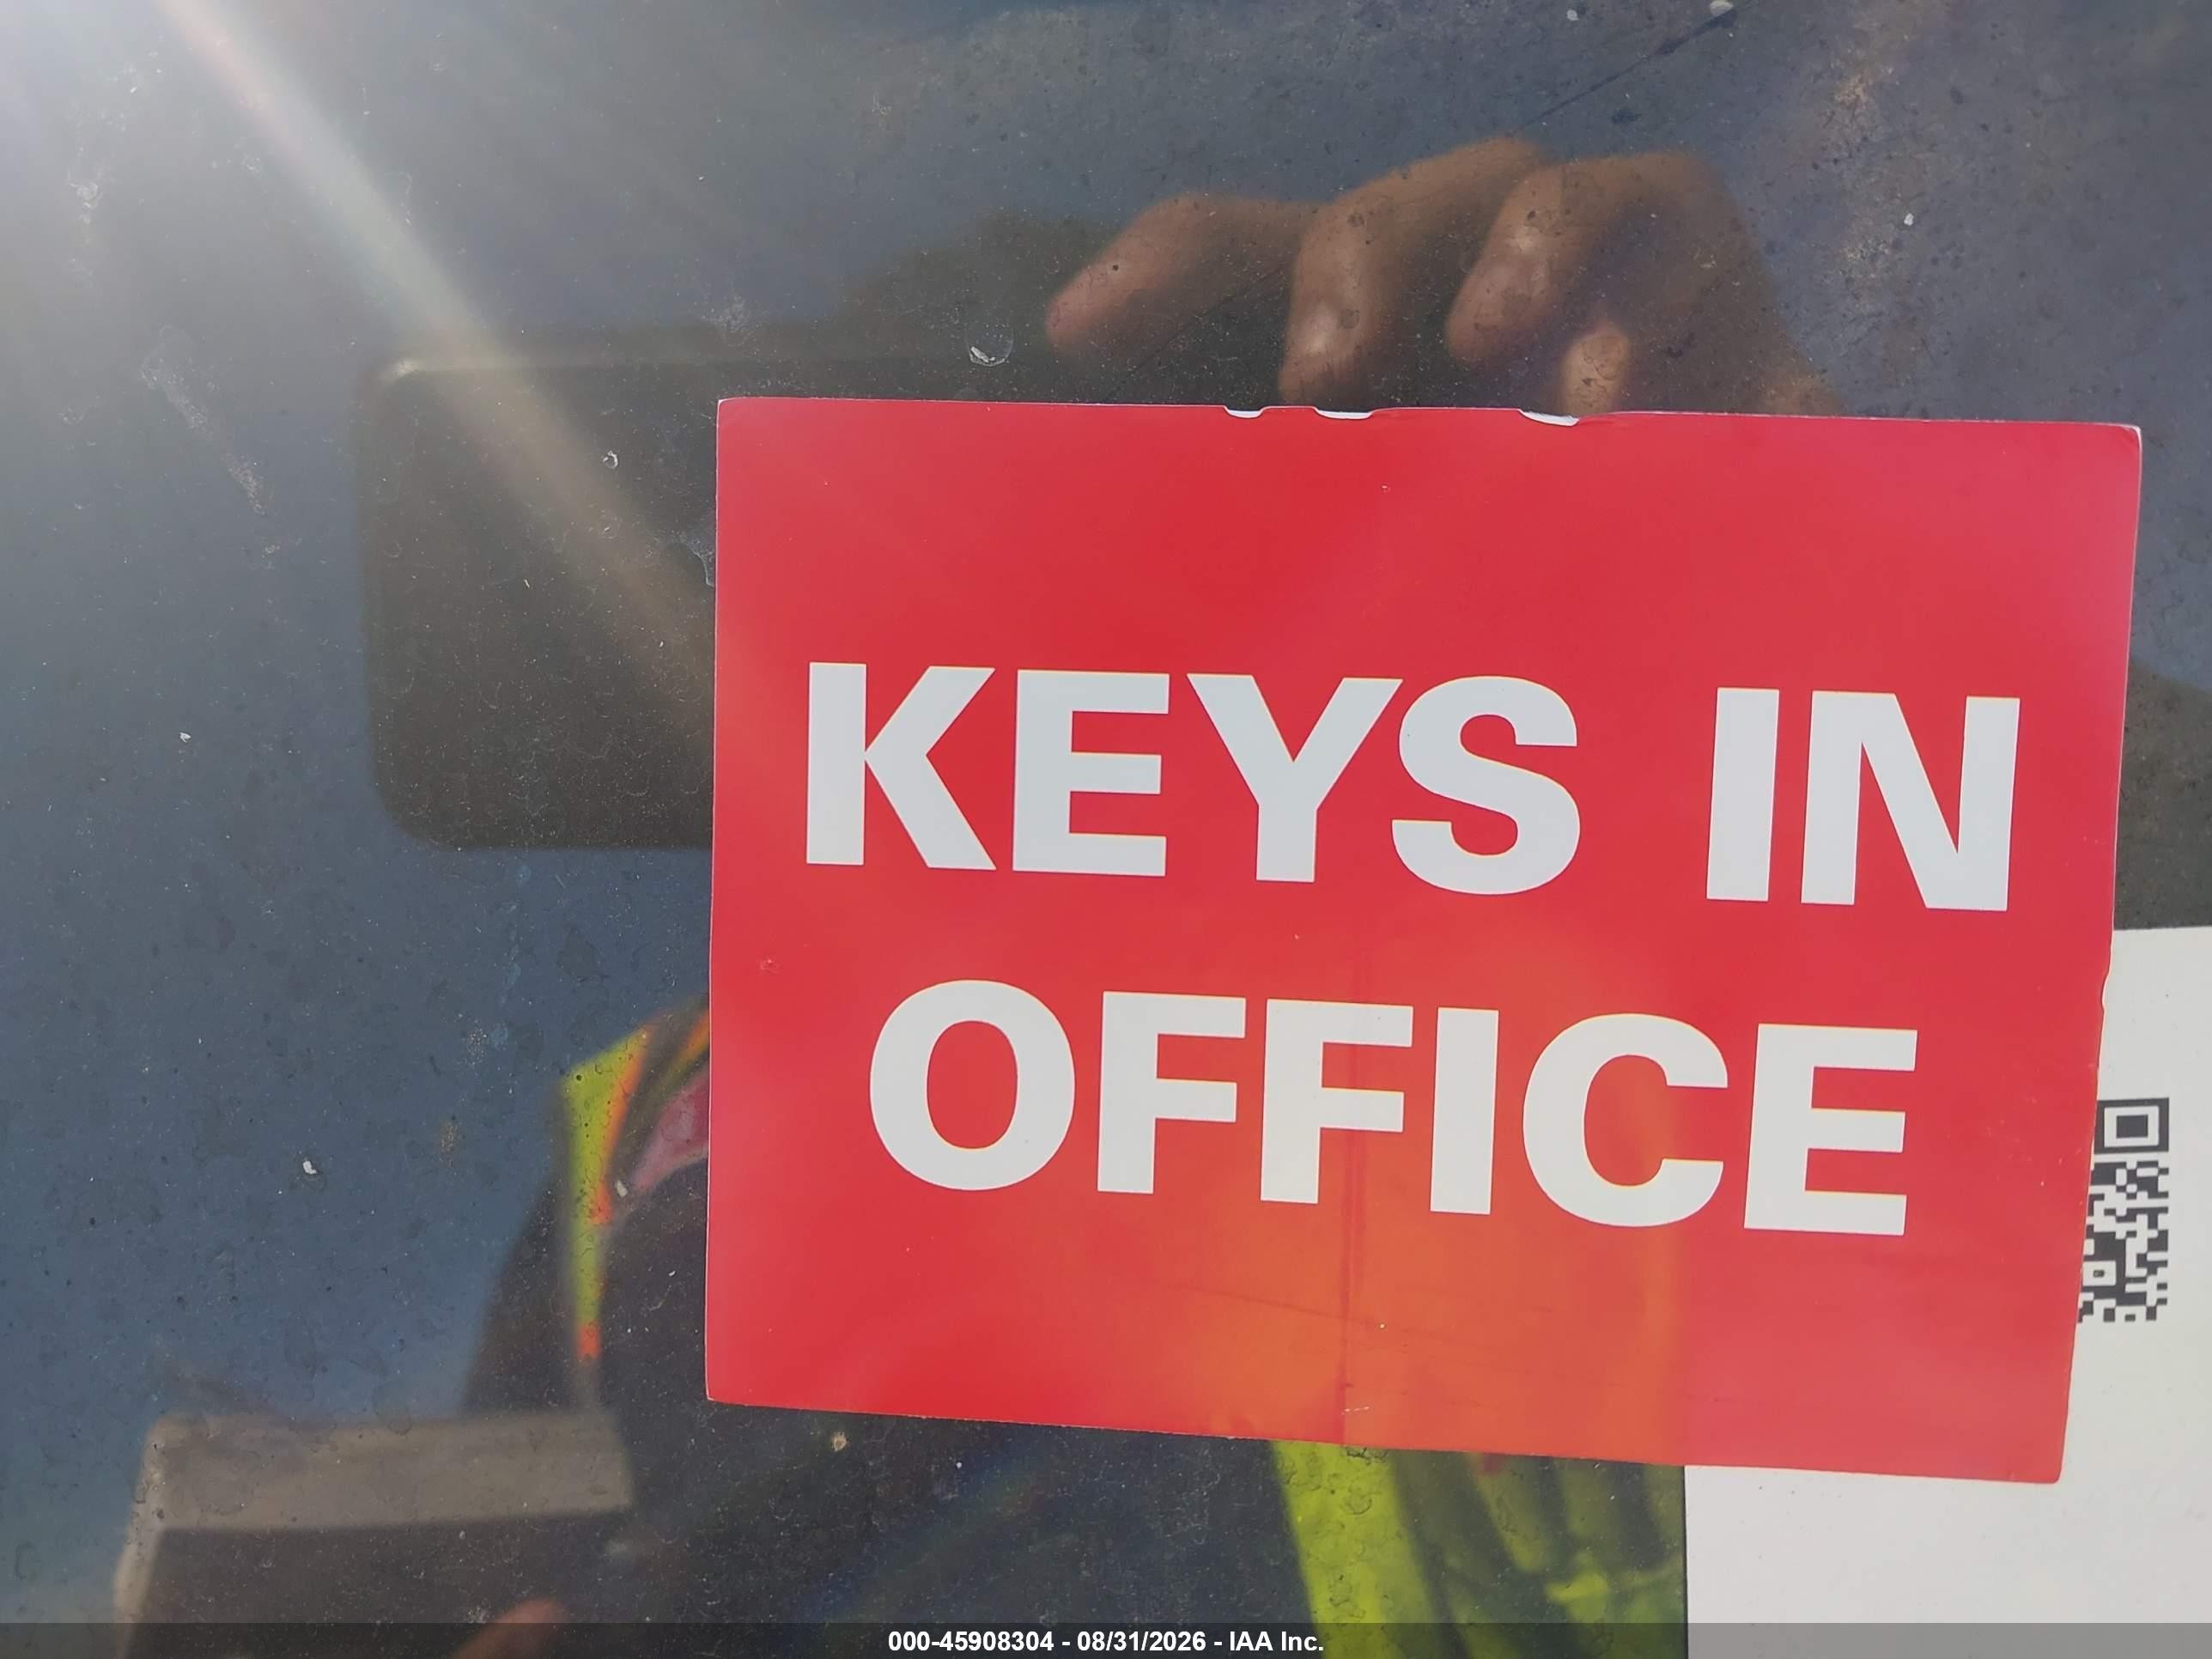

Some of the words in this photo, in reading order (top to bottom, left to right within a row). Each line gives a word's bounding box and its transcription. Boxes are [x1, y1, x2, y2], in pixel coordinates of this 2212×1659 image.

[805, 661, 1580, 896] KEYS
[1705, 687, 2021, 914] IN
[869, 980, 1918, 1237] OFFICE
